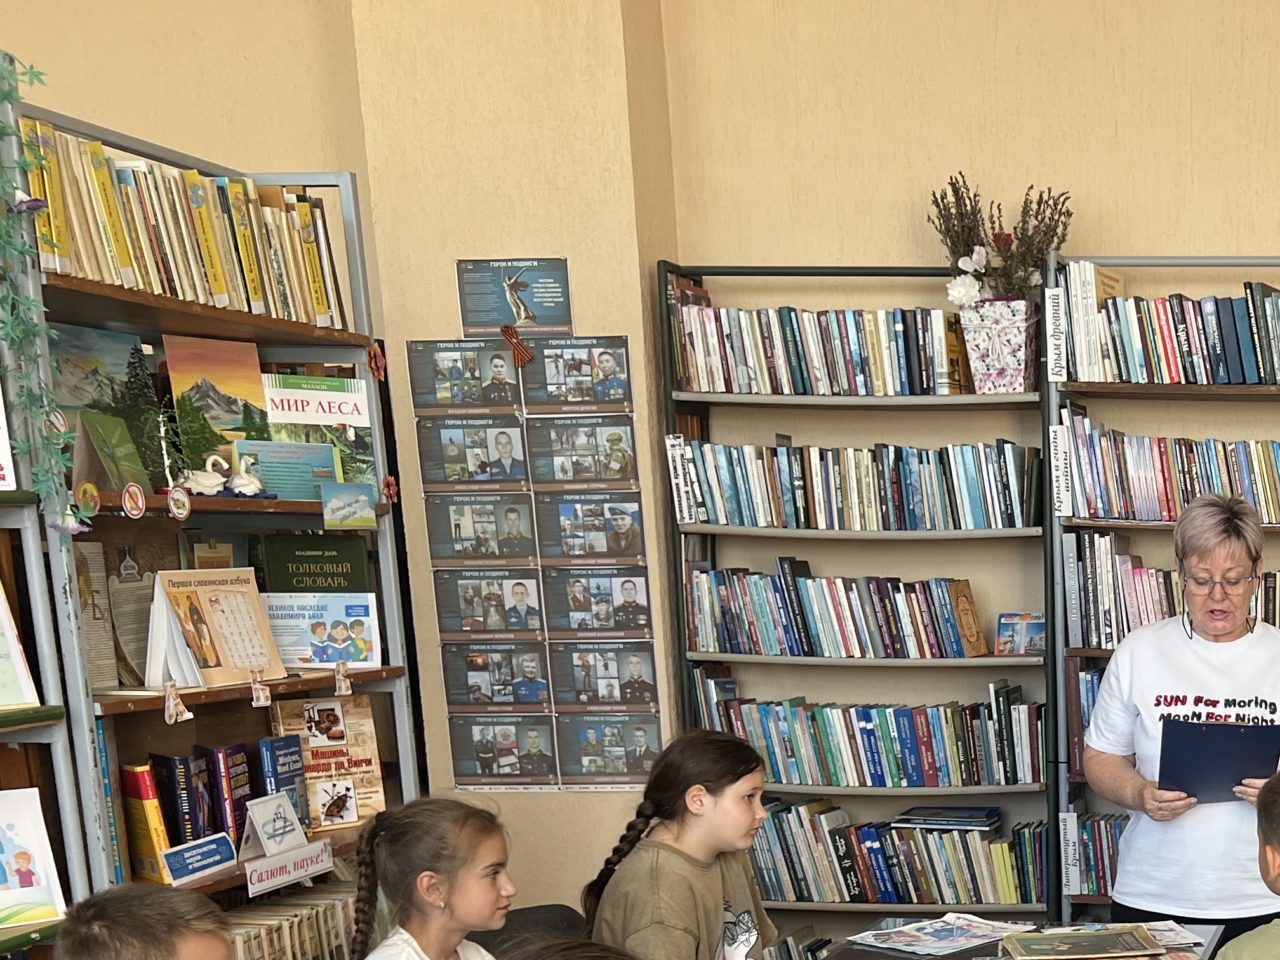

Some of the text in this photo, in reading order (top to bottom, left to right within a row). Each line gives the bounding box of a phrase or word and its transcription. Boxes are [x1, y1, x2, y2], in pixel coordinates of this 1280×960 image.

[1049, 293, 1064, 377] Крым древний
[1177, 323, 1190, 352] Крым
[270, 398, 362, 415] МИР ЛЕСА
[1050, 429, 1061, 462] годы
[1052, 474, 1064, 513] Крым
[287, 562, 351, 574] ТОЛКОВЫЙ
[168, 576, 251, 589] Первая славянская азбука
[293, 576, 348, 587] СЛОВАРЬ
[1154, 695, 1188, 707] SUN
[1224, 696, 1277, 715] Moring
[304, 757, 373, 774] нардо да Винчи
[311, 748, 349, 760] Машины
[1061, 817, 1071, 891] Литературный
[1071, 841, 1079, 868] Крым
[249, 848, 324, 886] Салют, науке!
